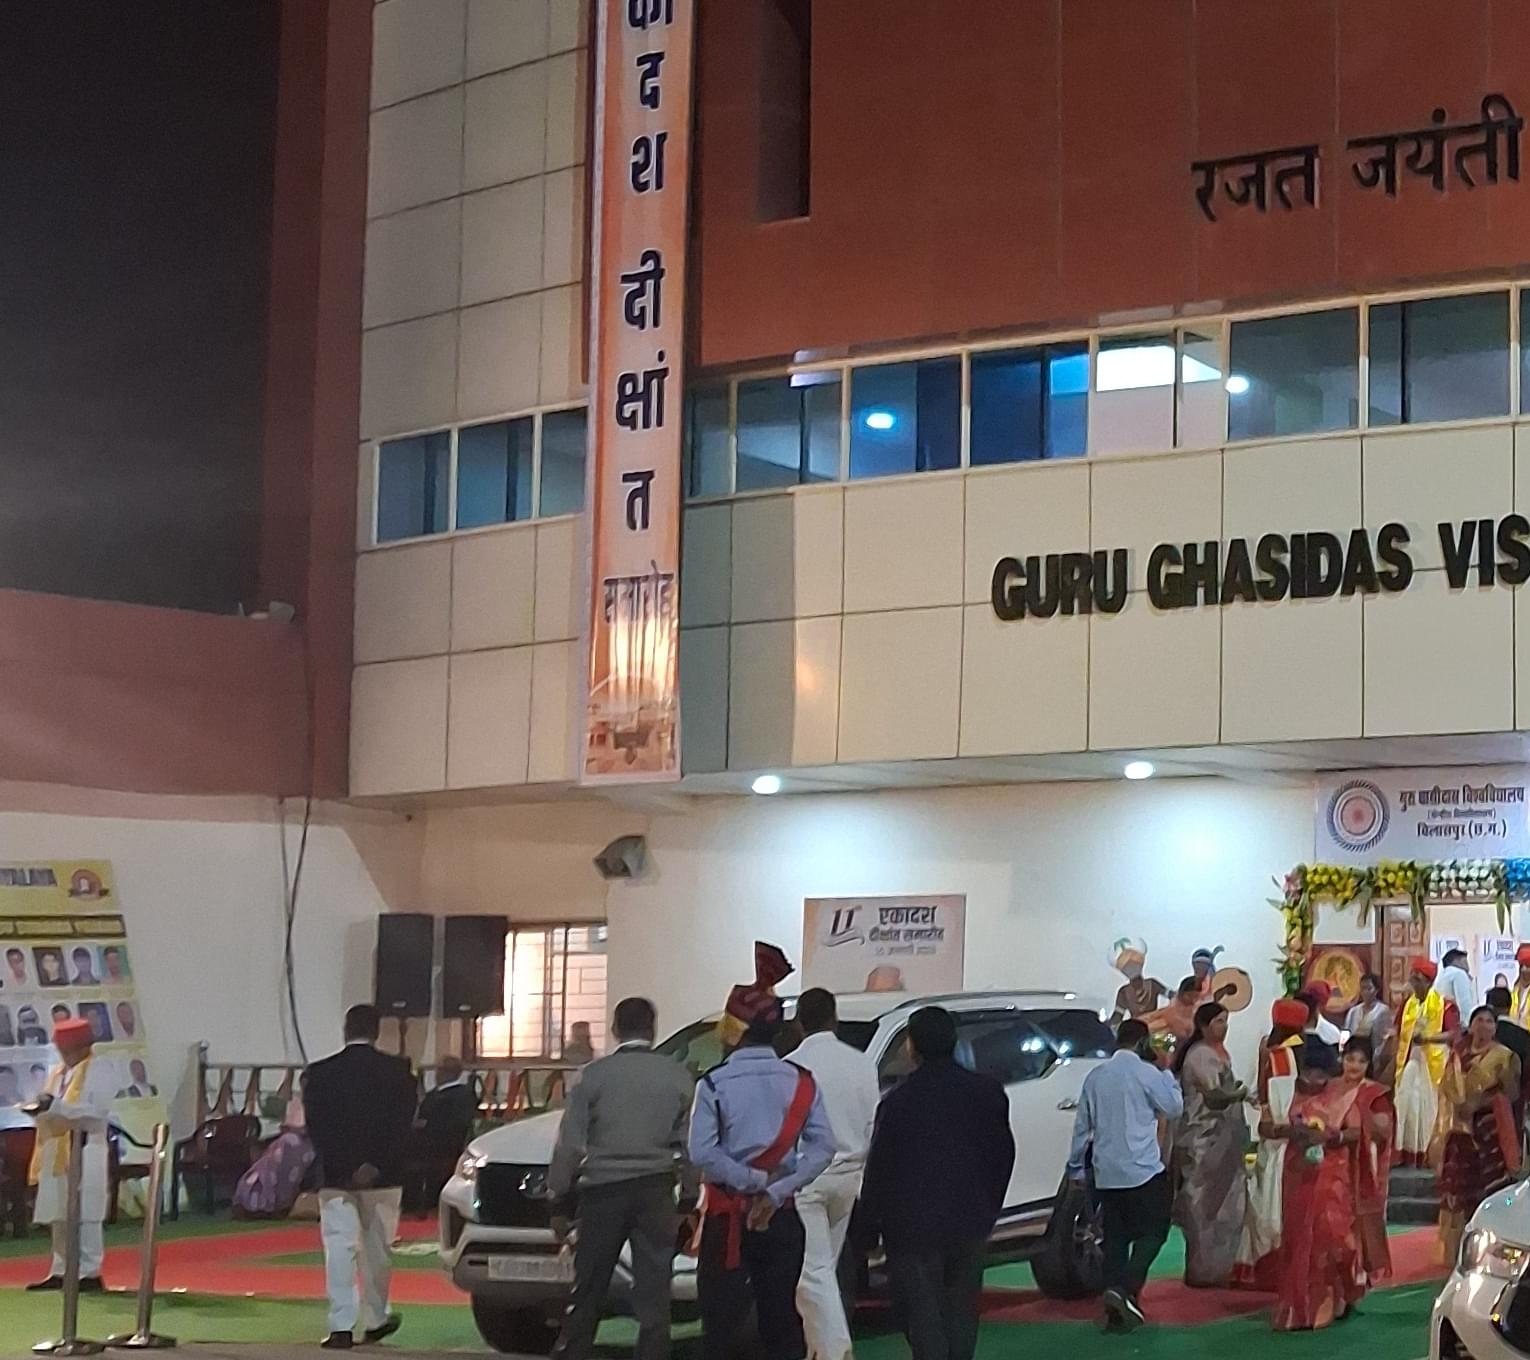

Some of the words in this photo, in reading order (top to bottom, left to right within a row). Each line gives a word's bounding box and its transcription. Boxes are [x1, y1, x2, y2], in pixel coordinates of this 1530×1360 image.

[1190, 144, 1320, 222] रजत
[1347, 94, 1525, 197] जयंती
[991, 547, 1128, 621] GURU
[1146, 522, 1415, 610] GHASIDAS
[879, 906, 937, 925] एकादश
